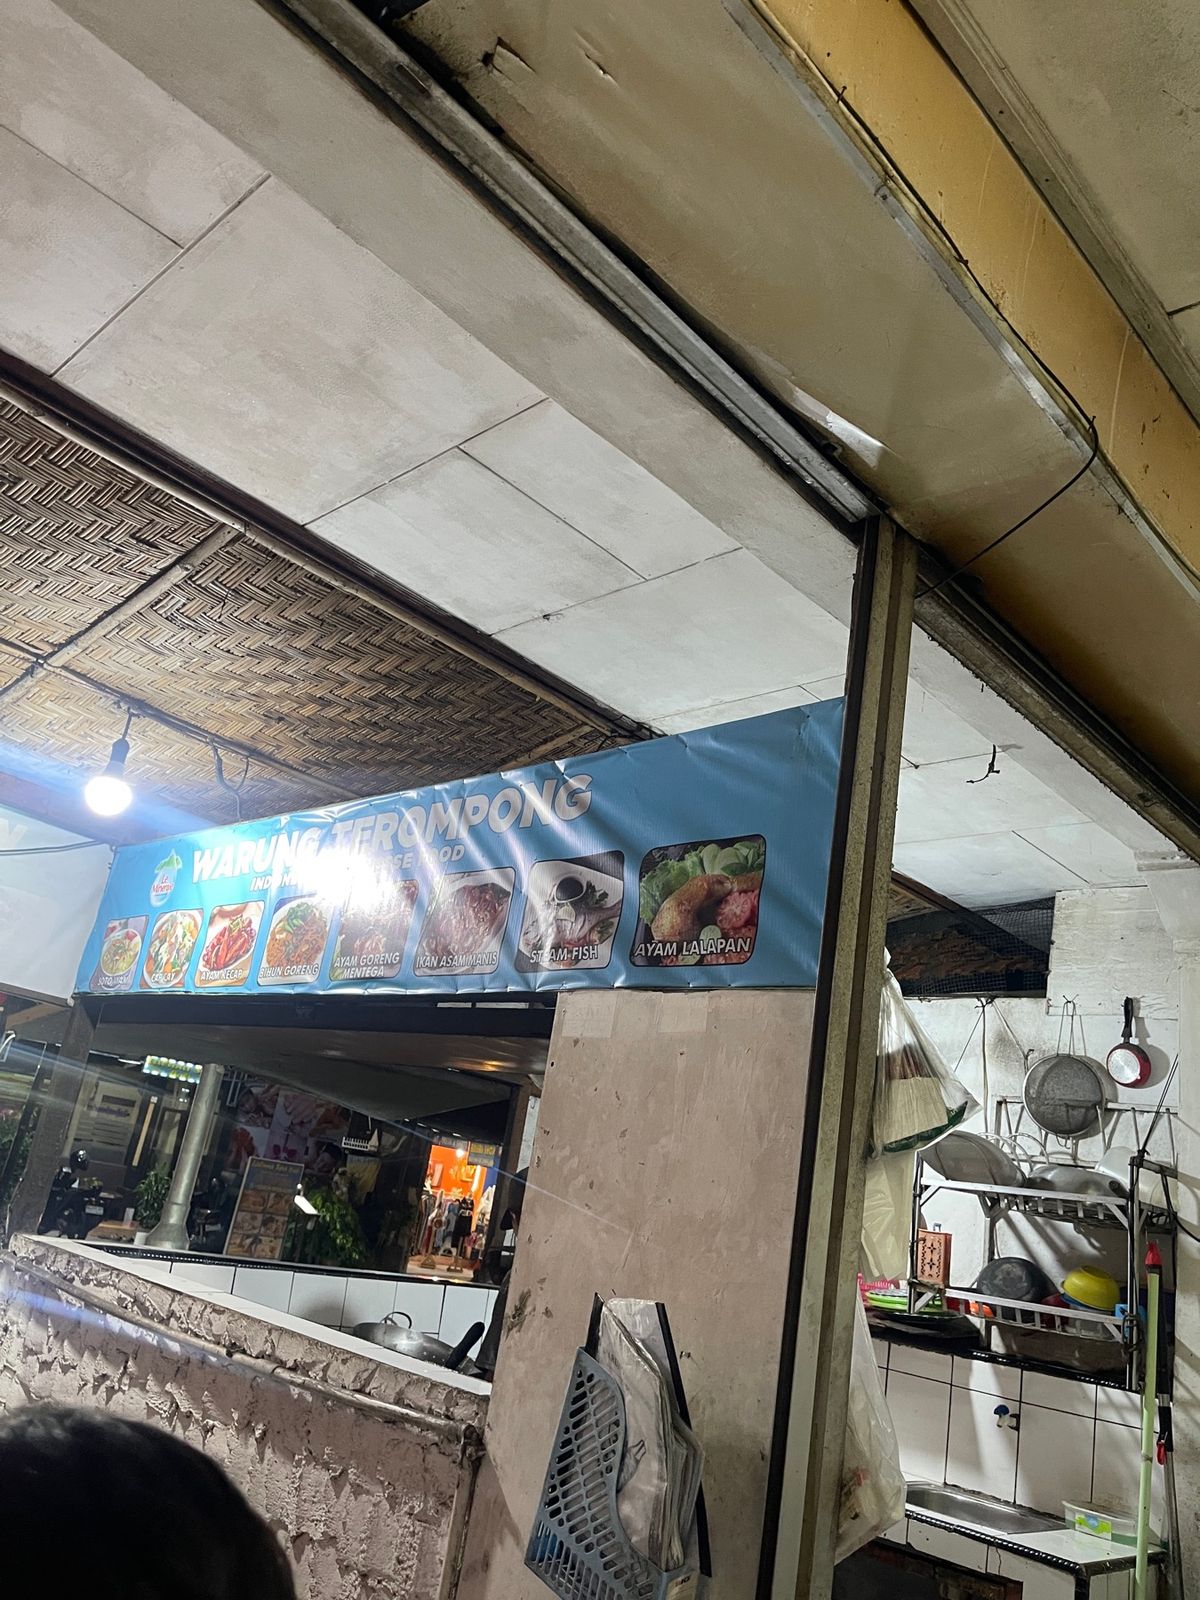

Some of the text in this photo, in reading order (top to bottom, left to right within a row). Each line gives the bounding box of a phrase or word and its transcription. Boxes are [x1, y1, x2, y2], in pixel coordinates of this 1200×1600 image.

[191, 773, 592, 884] WARUNG TEROMPONG
[529, 944, 599, 964] STAM FISH
[634, 937, 752, 957] AYAM LALAPAN
[334, 951, 400, 968] AYAM GORENG
[415, 951, 498, 968] IKAN ASAM MANIS
[200, 969, 220, 980] AYAM
[259, 962, 320, 979] BIHUN GORENG
[342, 965, 385, 979] MENTEGA
